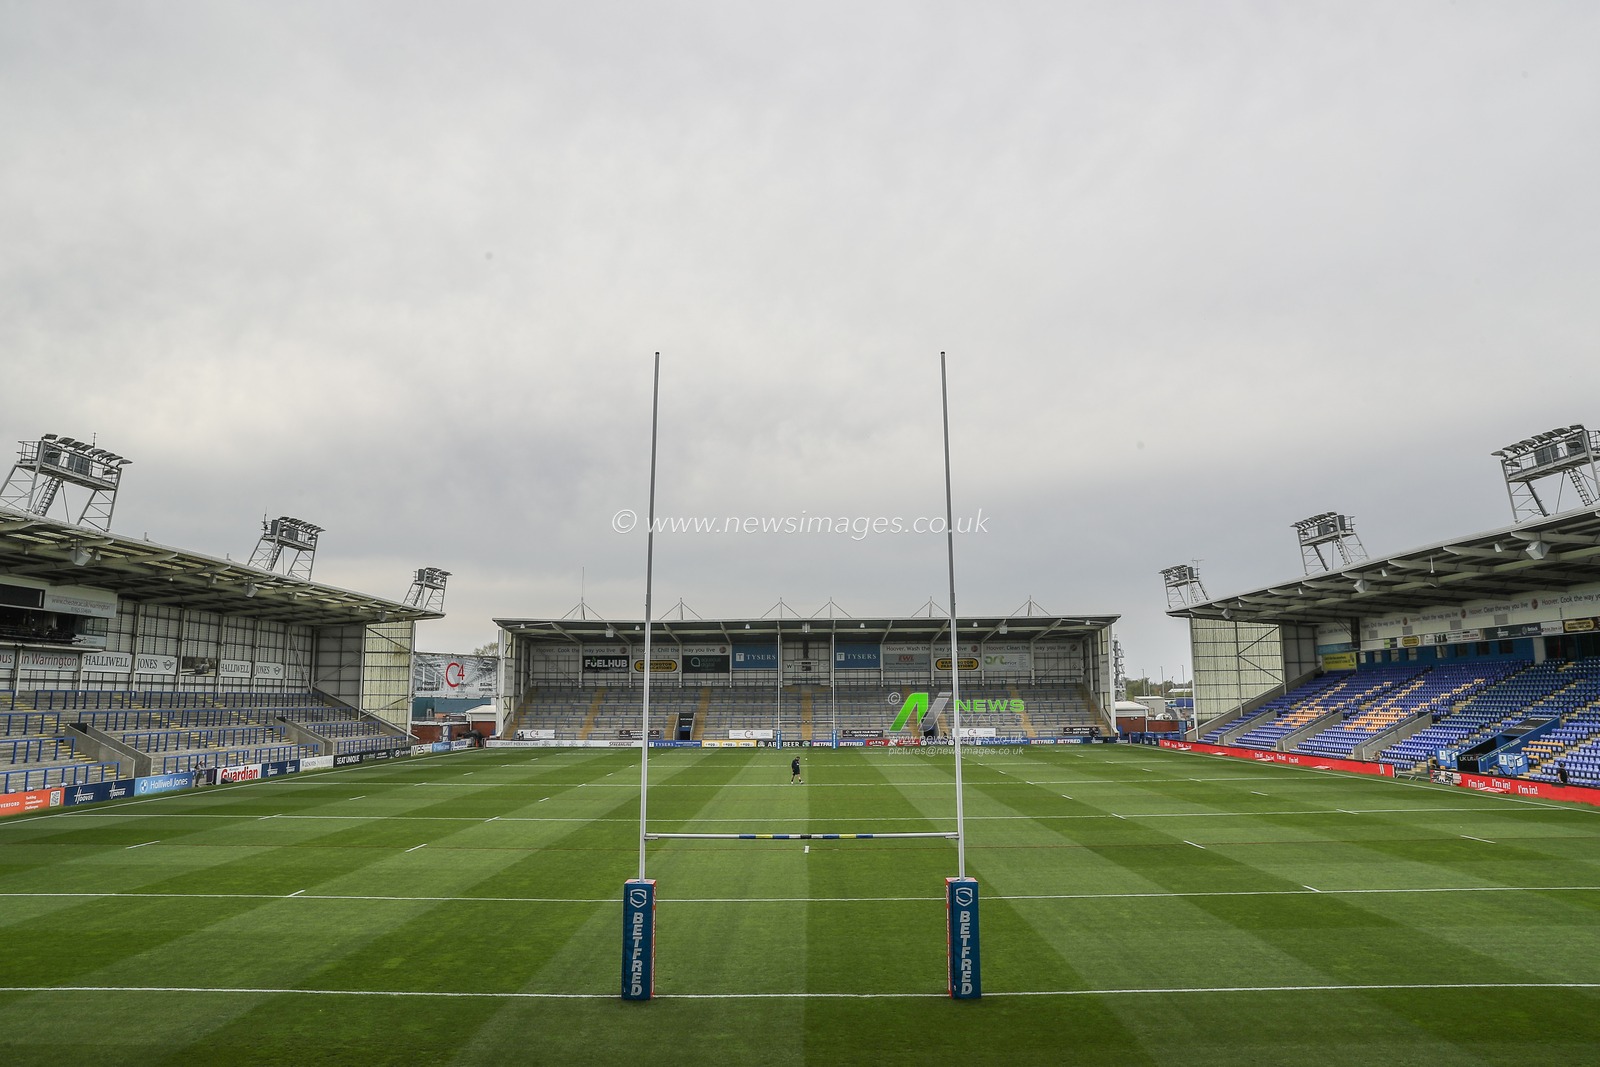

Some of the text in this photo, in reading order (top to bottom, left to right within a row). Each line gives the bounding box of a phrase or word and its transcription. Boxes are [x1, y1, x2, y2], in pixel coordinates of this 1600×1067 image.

[1560, 596, 1572, 604] Cook
[21, 653, 78, 669] in Warrington
[85, 655, 129, 668] HALLIWELL
[138, 658, 158, 671] JONES
[585, 657, 628, 668] FUELHUB
[220, 663, 250, 674] HALLIWELL
[221, 766, 258, 781] Guardian
[173, 778, 188, 787] Jones
[1491, 778, 1502, 788] I'm
[1517, 785, 1539, 795] I'm in!
[631, 912, 644, 996] BETFRED
[959, 910, 973, 995] BETFRED
